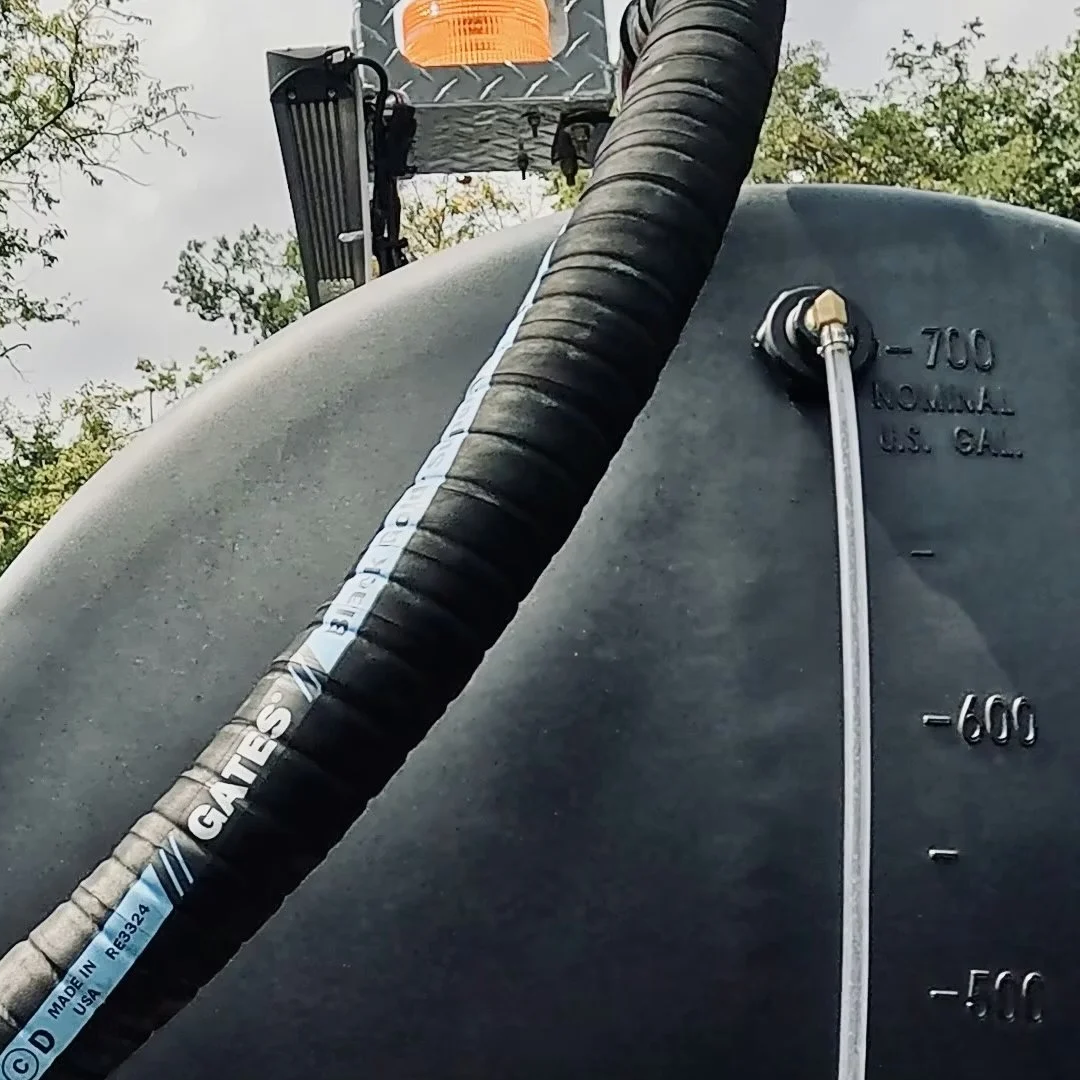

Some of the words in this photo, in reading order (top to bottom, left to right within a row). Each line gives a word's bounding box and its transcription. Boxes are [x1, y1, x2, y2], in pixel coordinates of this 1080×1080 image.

[921, 326, 995, 372] 700
[956, 693, 1037, 745] 600
[187, 703, 292, 840] GATES
[105, 903, 150, 960] RE3324
[47, 977, 84, 1020] MADE
[78, 959, 97, 981] IN
[73, 988, 101, 1016] USA
[966, 968, 1043, 1023] 500
[28, 1029, 56, 1056] D
